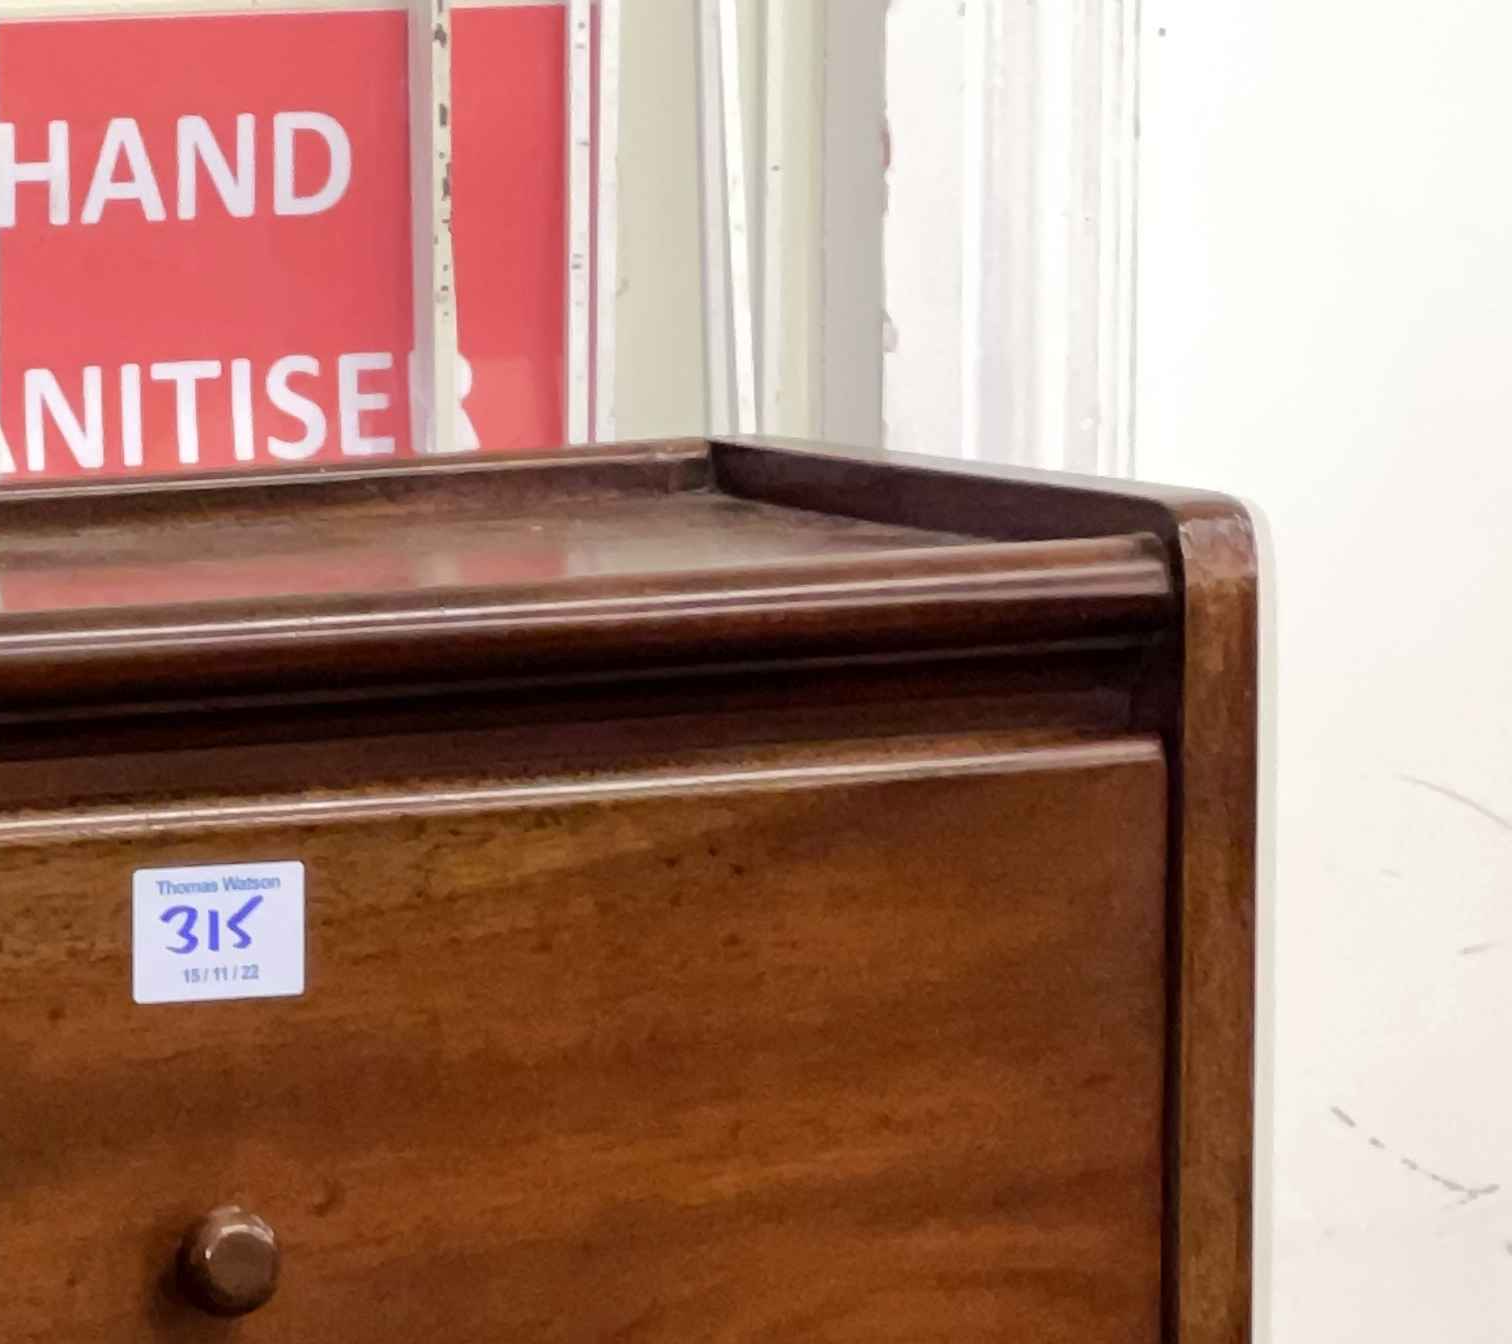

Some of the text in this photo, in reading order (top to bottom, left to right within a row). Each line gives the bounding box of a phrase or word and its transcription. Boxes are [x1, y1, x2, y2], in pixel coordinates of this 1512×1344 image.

[156, 876, 281, 896] Thomas Watson
[159, 894, 264, 955] 315
